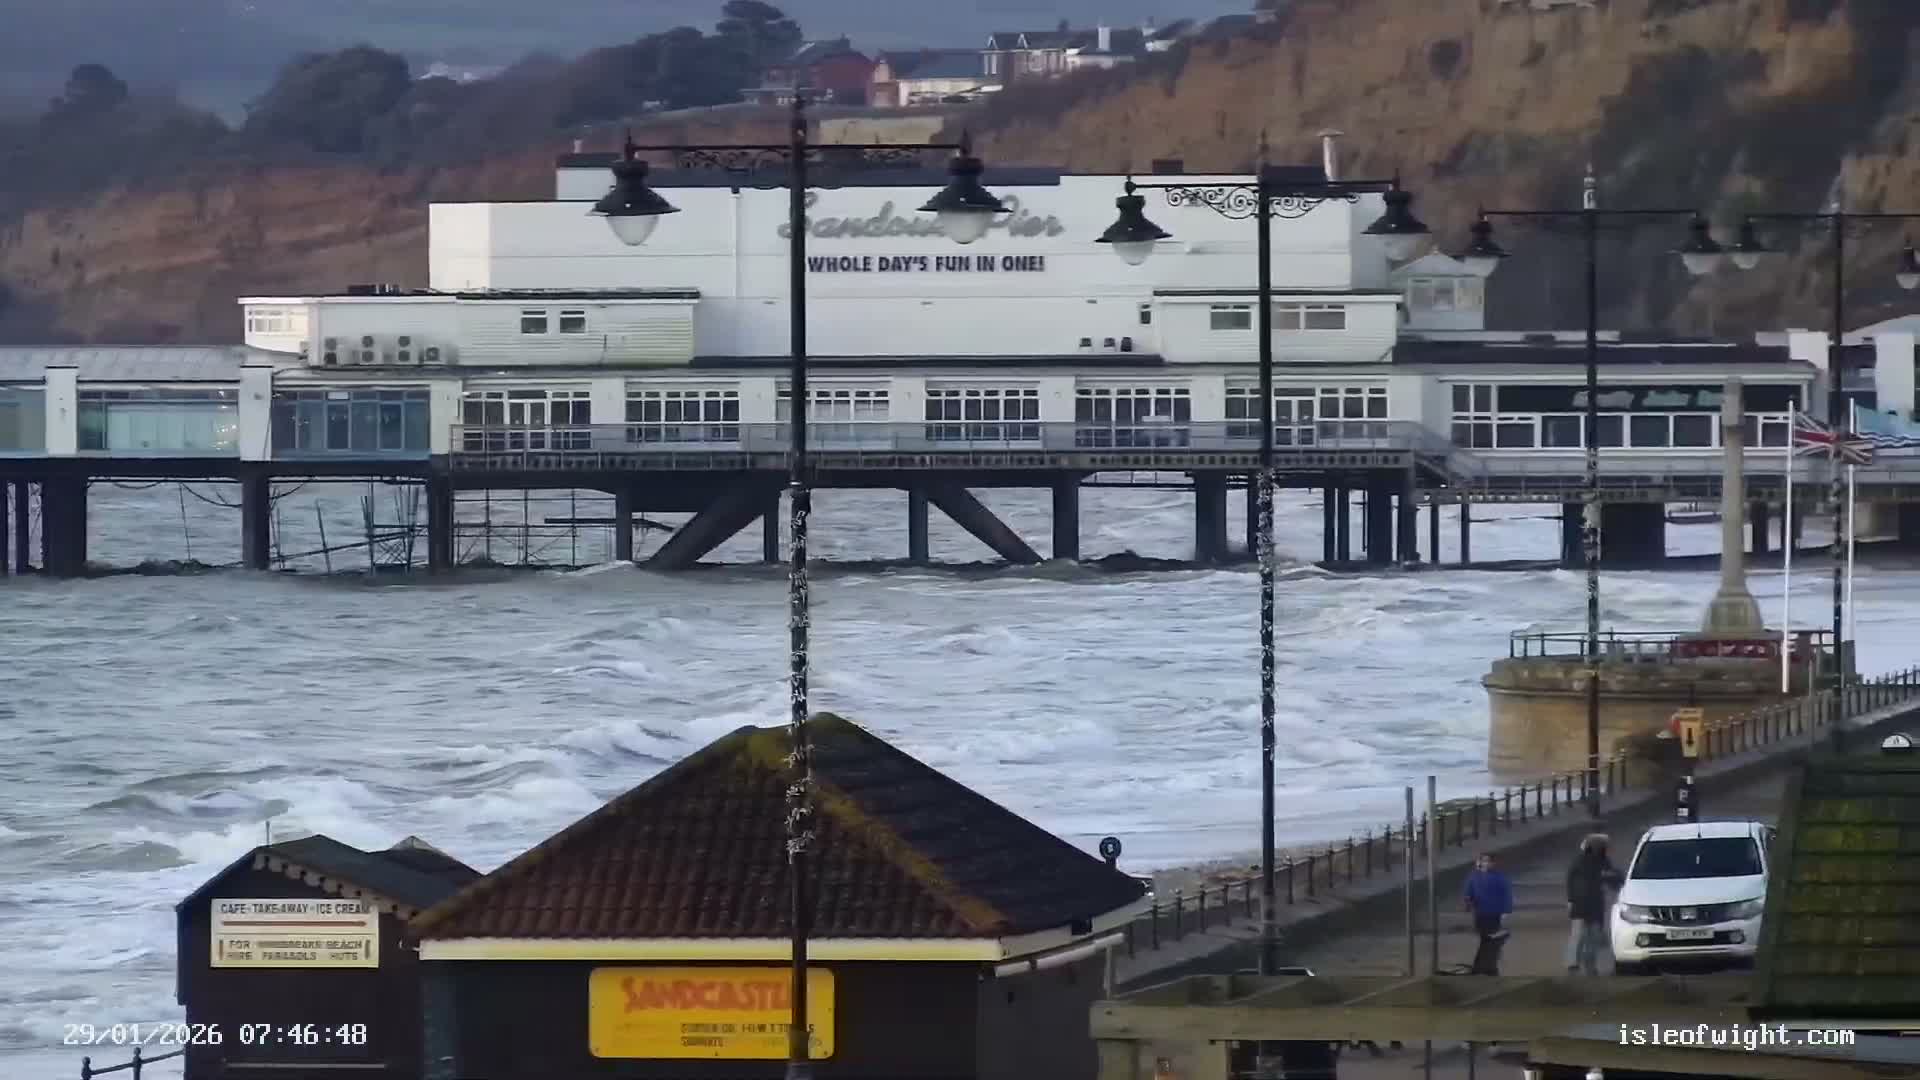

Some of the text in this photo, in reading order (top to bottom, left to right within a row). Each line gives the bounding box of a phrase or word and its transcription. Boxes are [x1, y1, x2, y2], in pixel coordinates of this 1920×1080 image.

[808, 255, 1045, 273] WHOLE DAY'S FUN IN ONE!
[621, 976, 793, 1014] SANDCASTL
